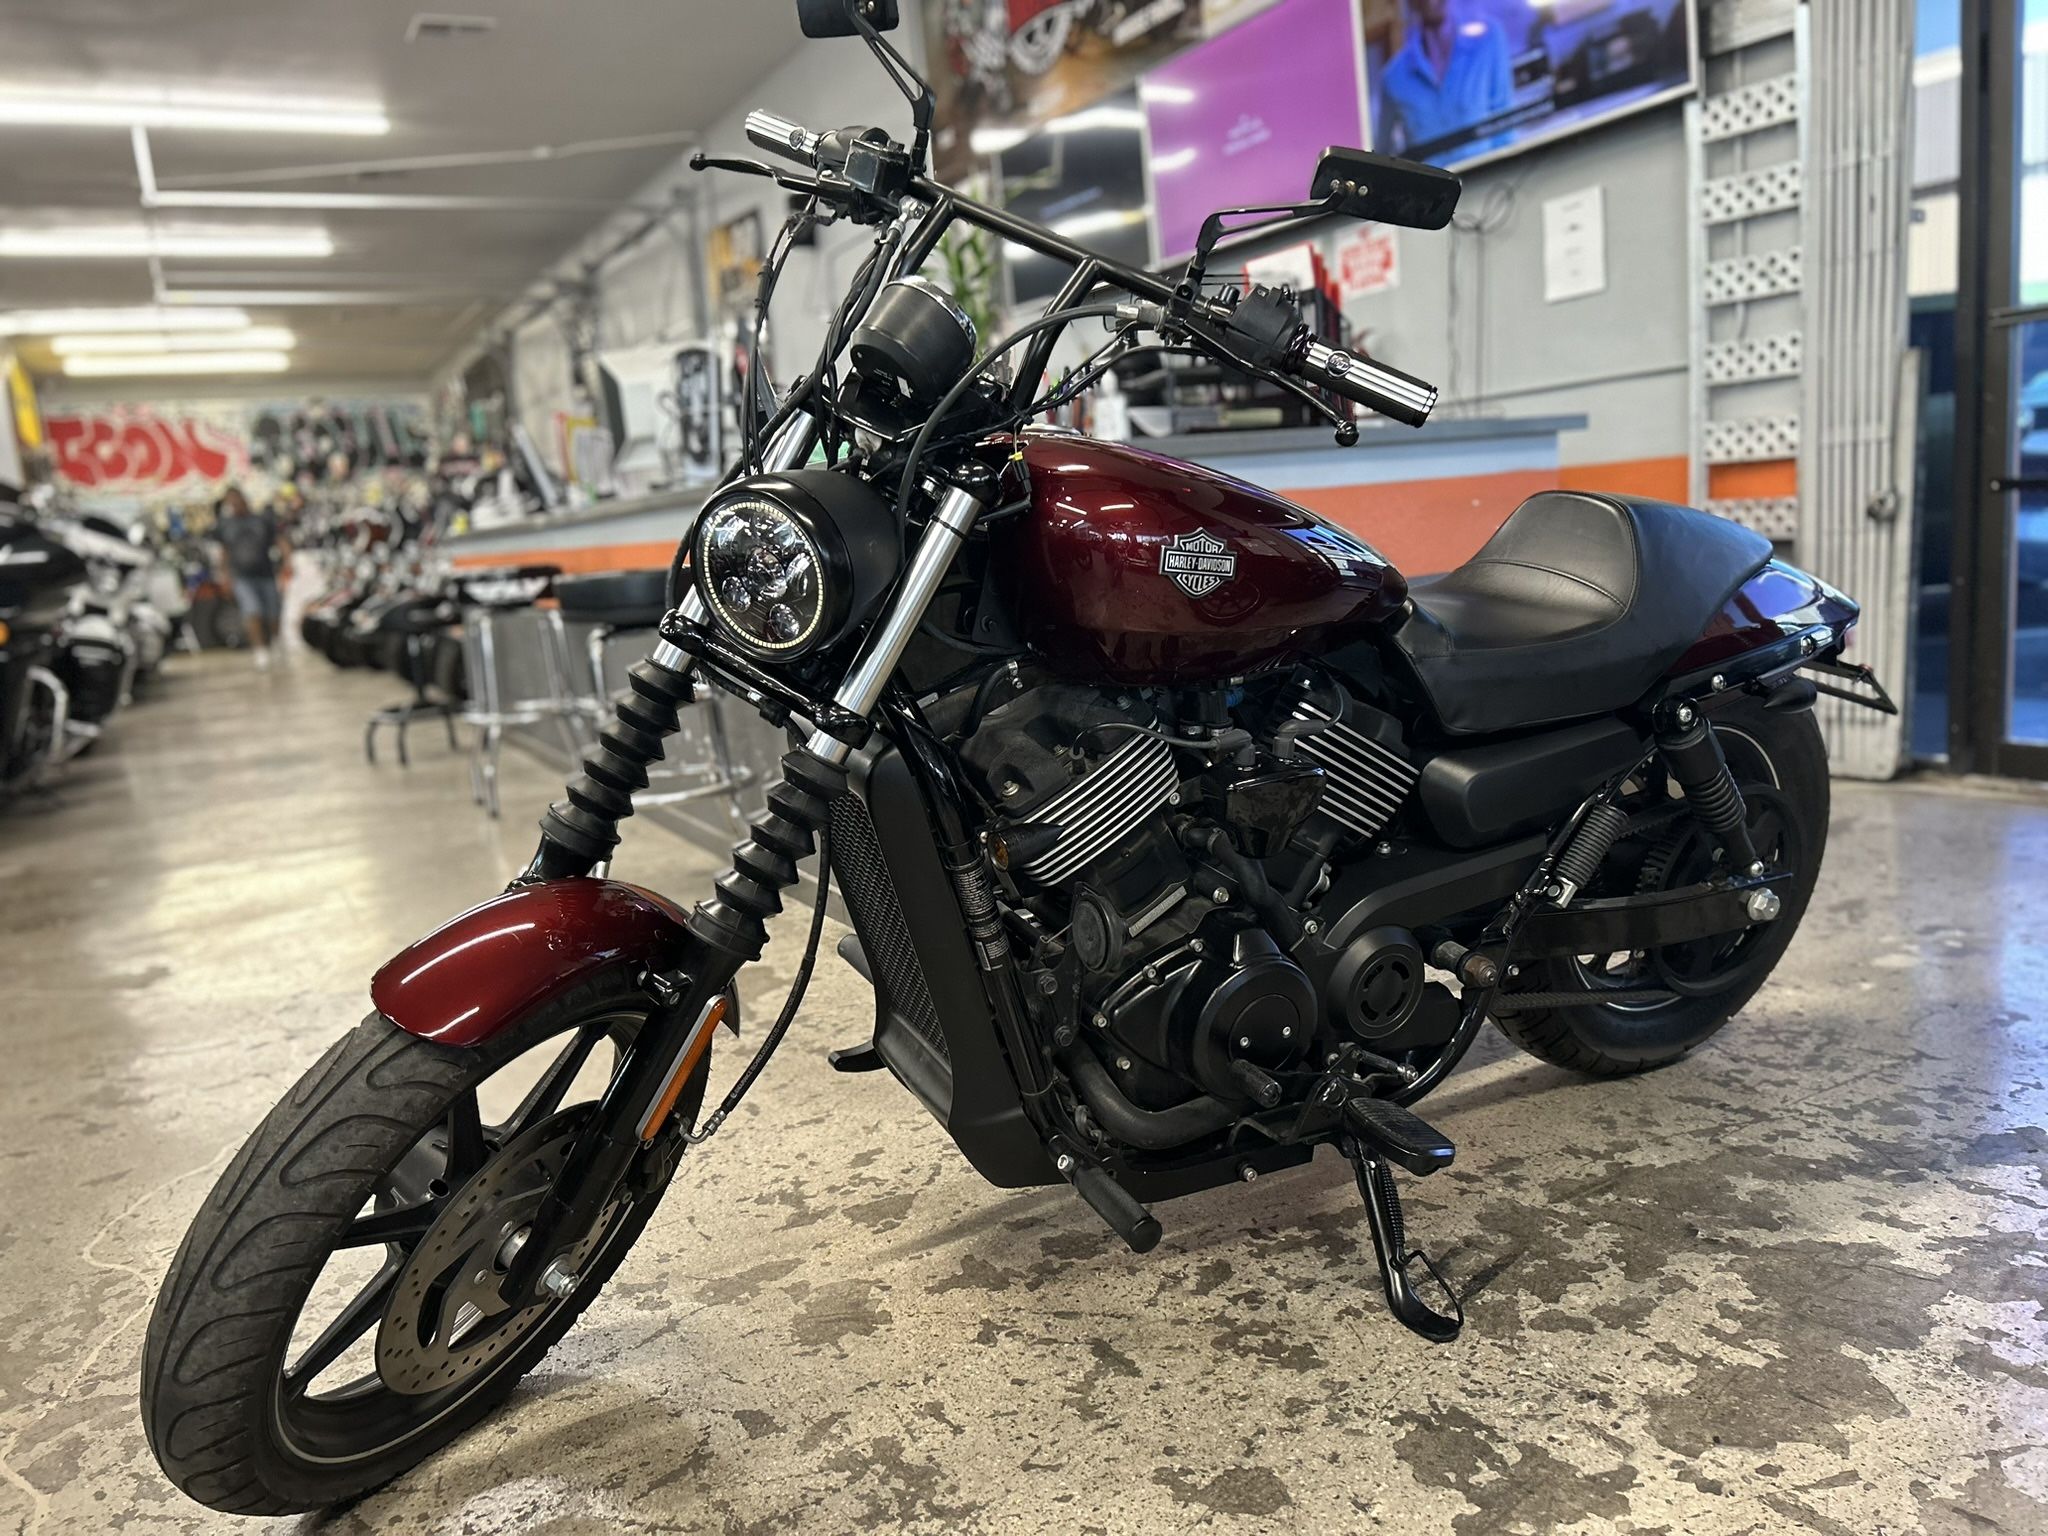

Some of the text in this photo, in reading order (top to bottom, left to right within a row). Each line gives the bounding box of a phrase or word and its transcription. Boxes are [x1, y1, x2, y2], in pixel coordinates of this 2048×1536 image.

[1185, 537, 1219, 554] MOTOR
[1168, 554, 1231, 573] HARLEY-DAVIDSON
[1181, 573, 1216, 592] CYCLES
